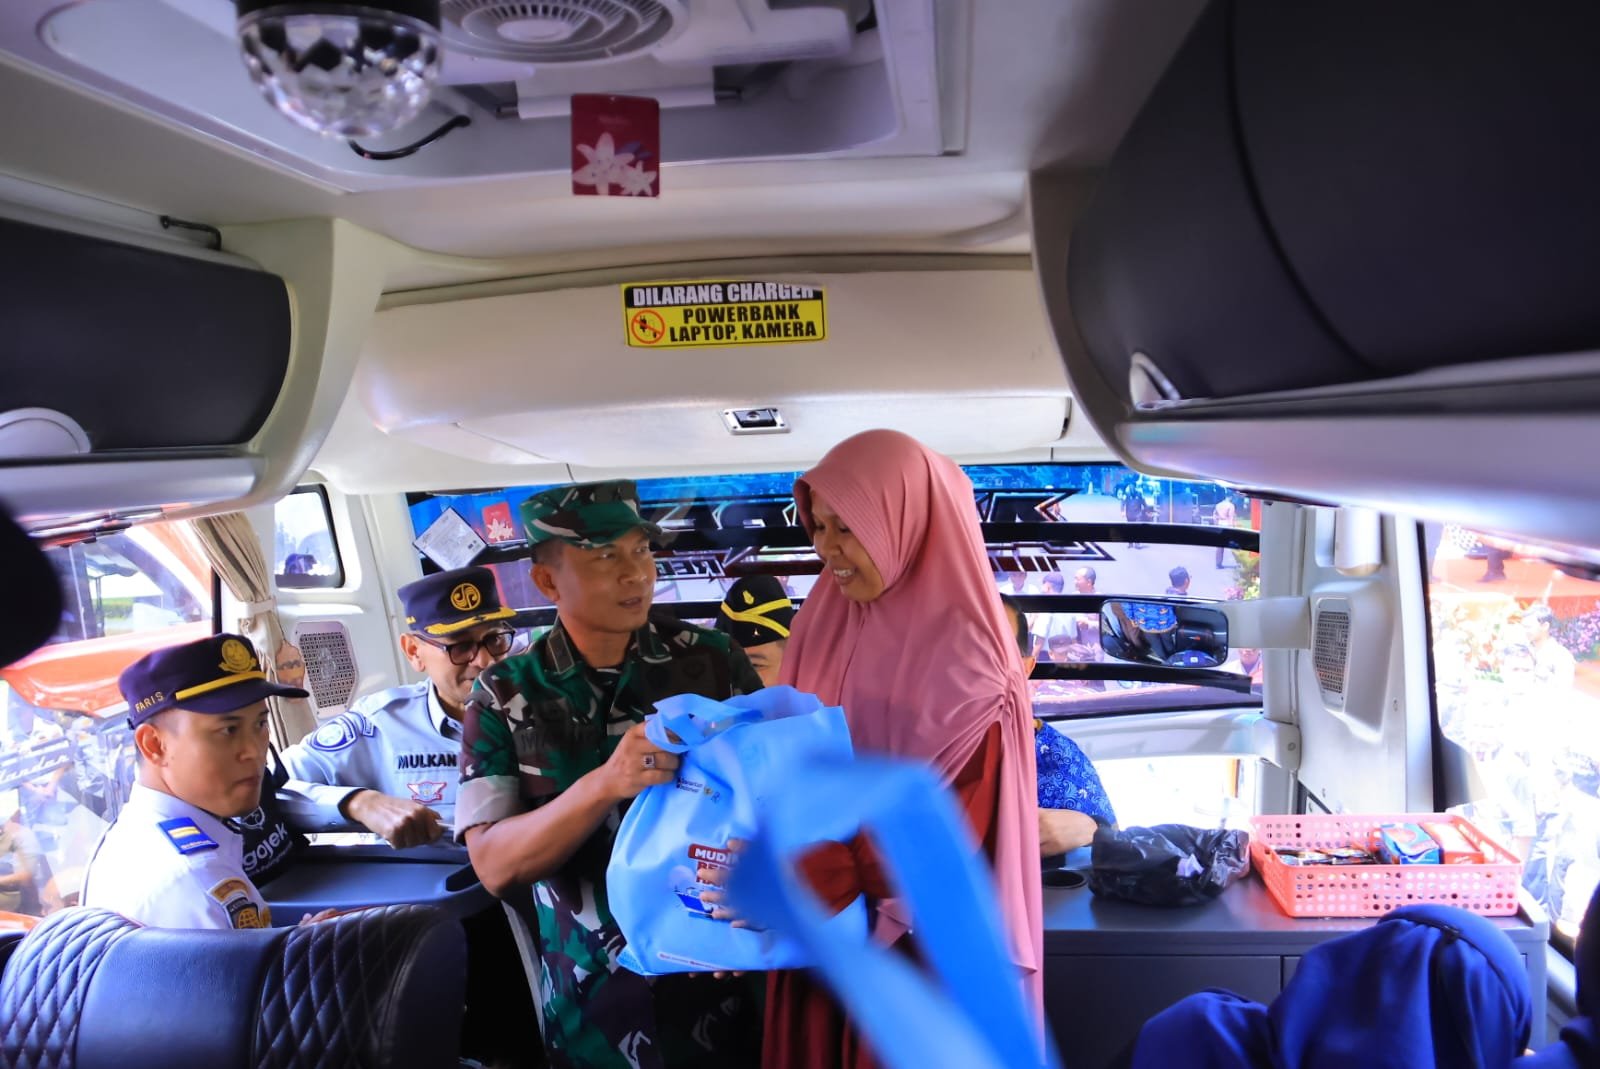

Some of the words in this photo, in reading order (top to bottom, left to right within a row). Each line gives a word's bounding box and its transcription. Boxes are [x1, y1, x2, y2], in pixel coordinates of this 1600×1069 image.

[633, 284, 723, 306] DILARANG
[683, 304, 800, 324] POWERBANK
[669, 324, 738, 342] LAPTOP,
[743, 321, 817, 339] KAMERA
[135, 691, 164, 713] FARIS
[398, 754, 457, 769] MULKAN
[243, 822, 288, 871] gojek
